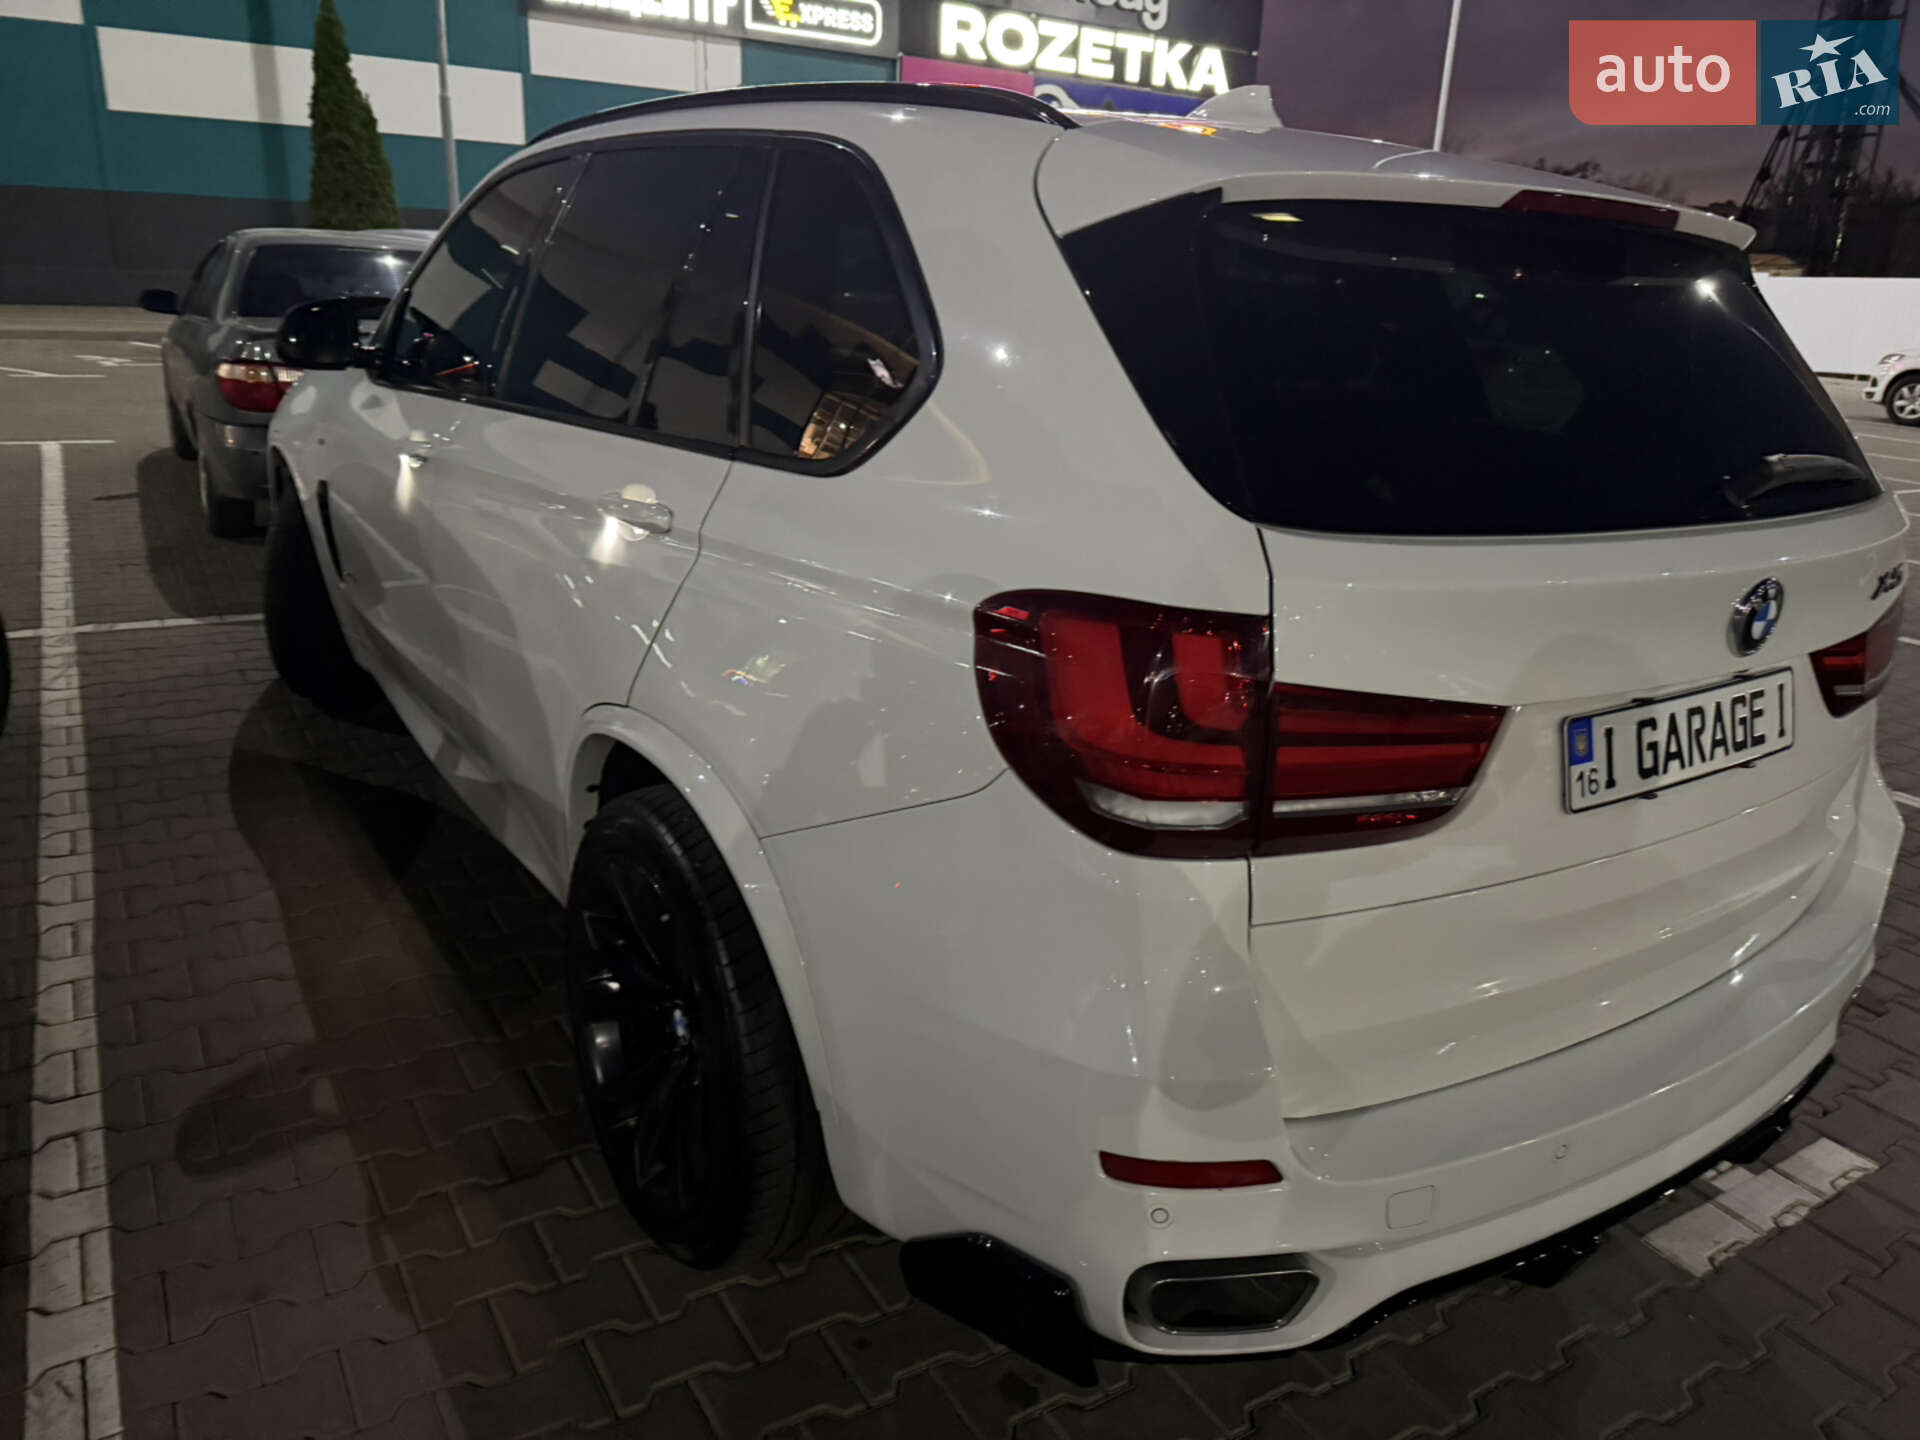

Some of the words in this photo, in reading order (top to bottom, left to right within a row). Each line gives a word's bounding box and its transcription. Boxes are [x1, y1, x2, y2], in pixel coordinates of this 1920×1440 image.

[939, 2, 1230, 95] ROZETKA
[1636, 689, 1766, 780] GARAGE
[1575, 768, 1599, 798] 16
